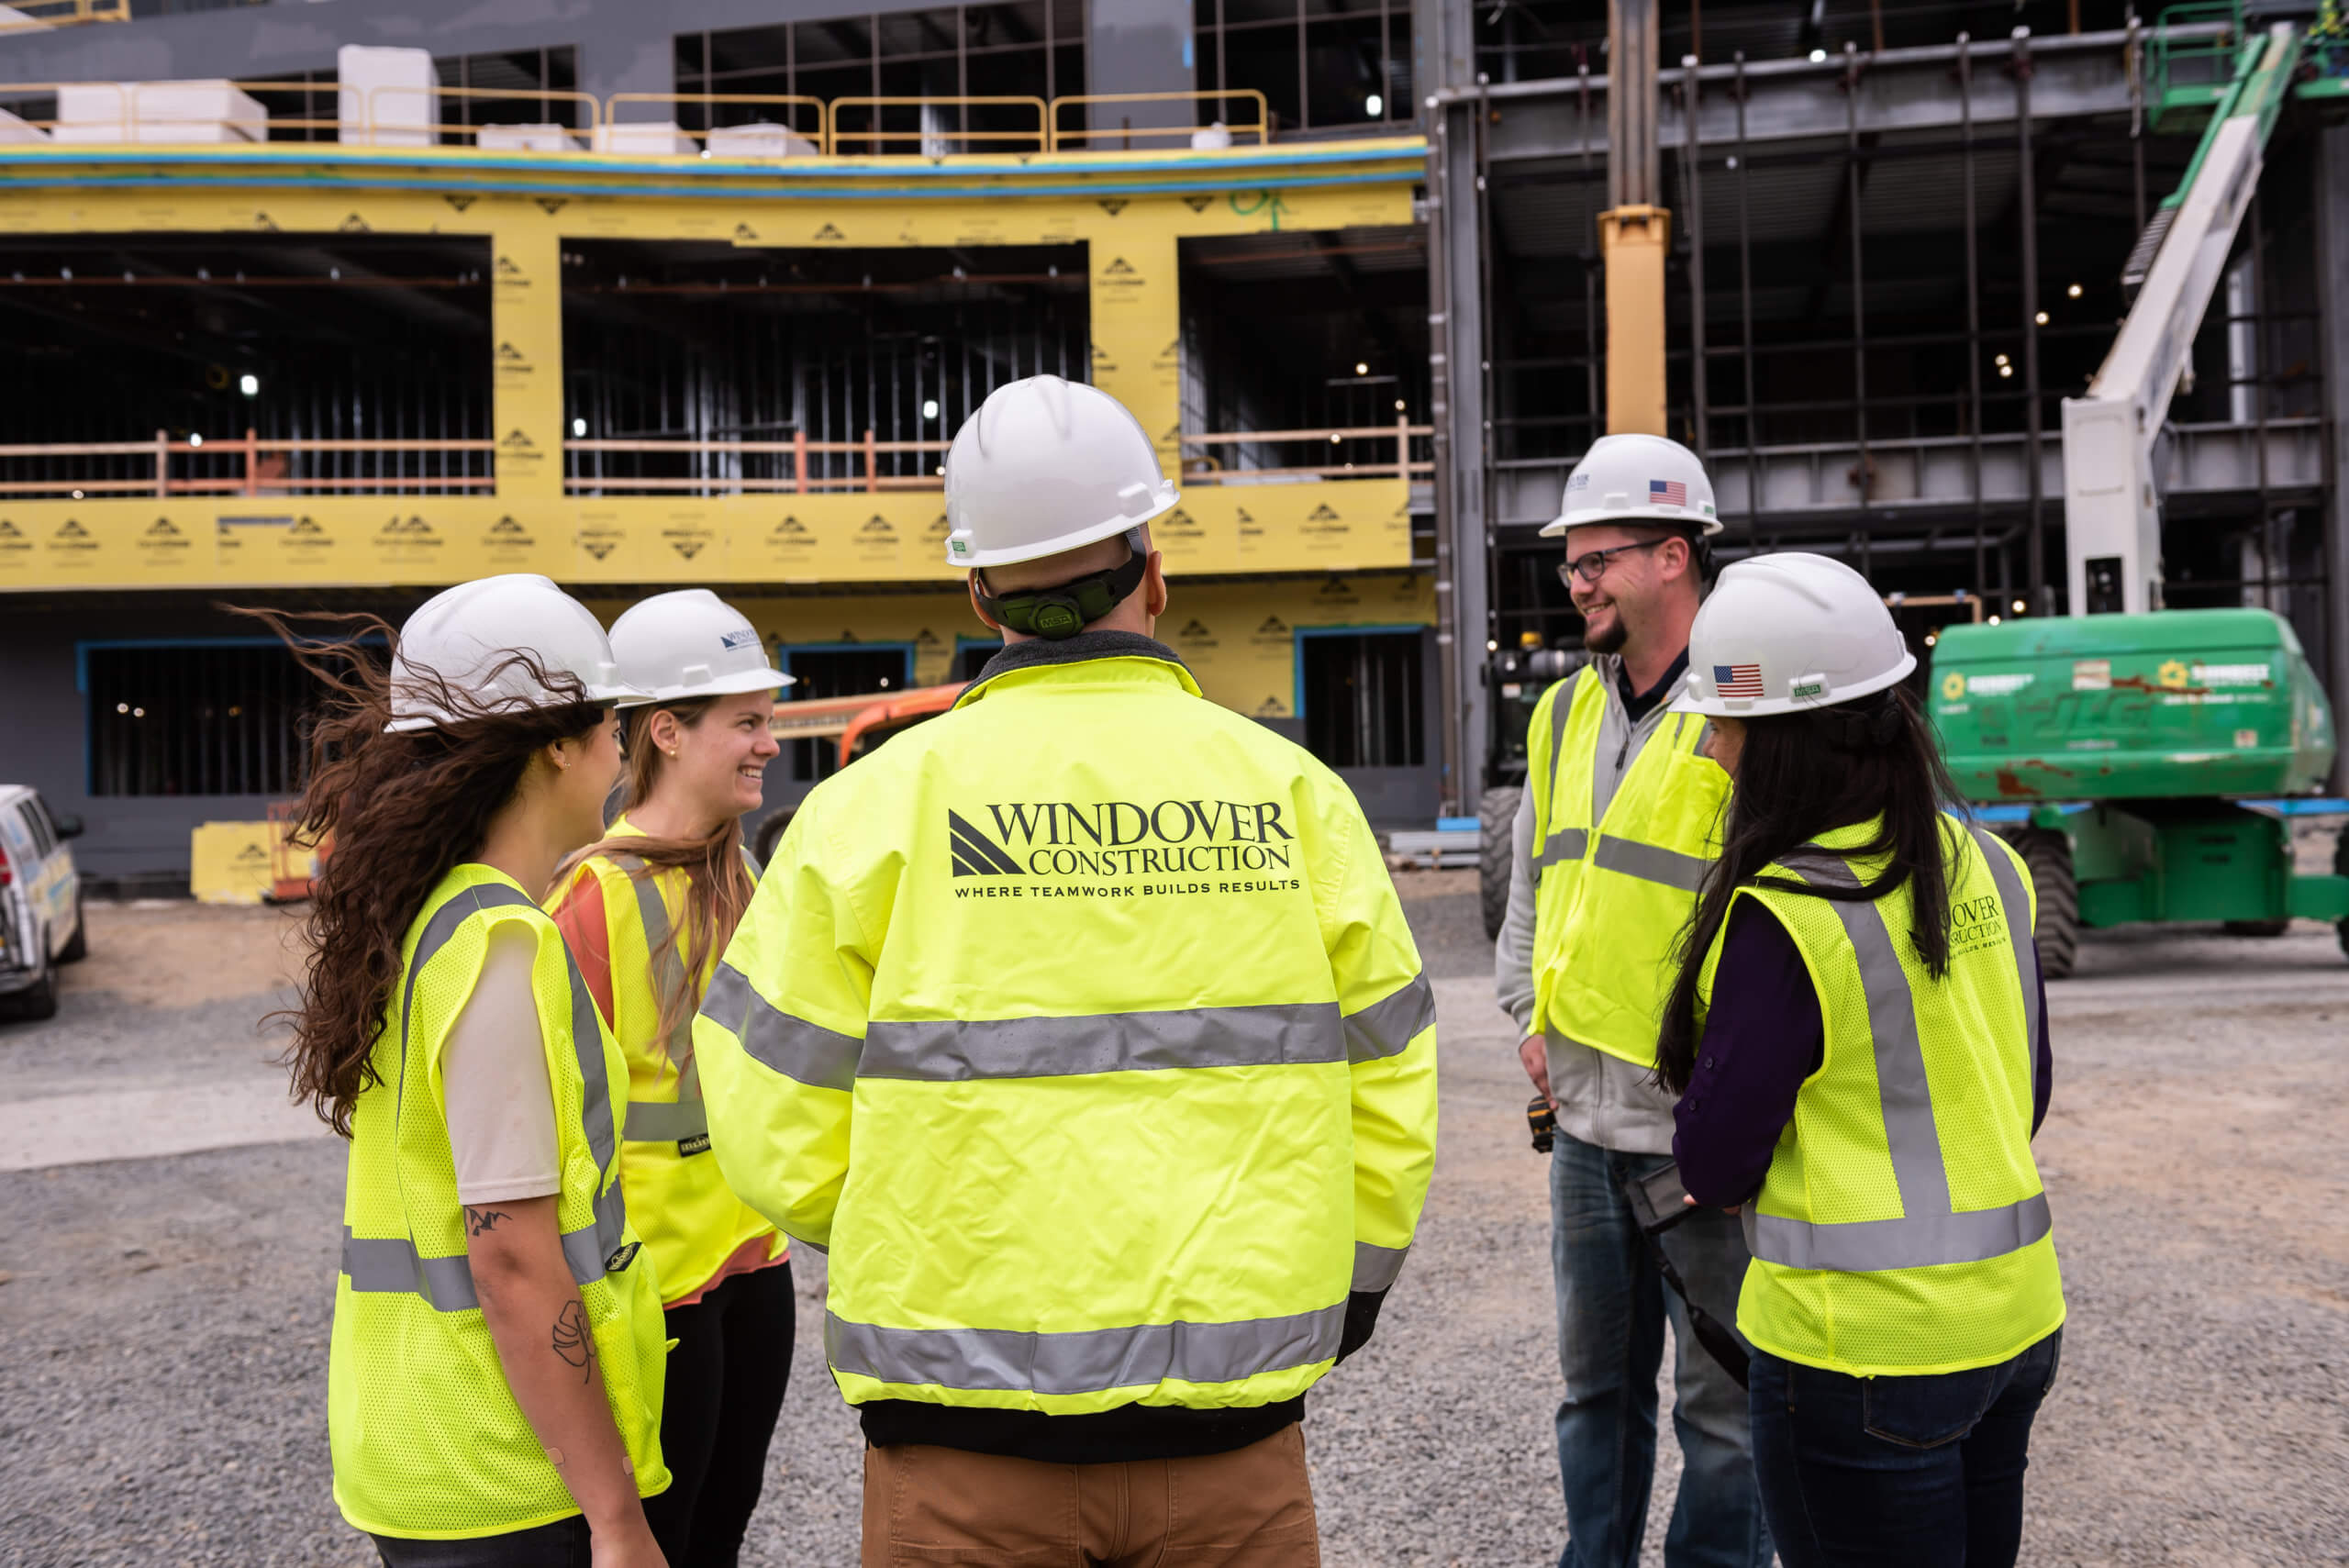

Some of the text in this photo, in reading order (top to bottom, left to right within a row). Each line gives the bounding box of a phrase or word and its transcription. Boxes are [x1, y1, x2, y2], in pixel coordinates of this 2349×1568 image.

[1795, 684, 1820, 697] MSA
[985, 800, 1296, 847] WINDOVER
[1028, 844, 1291, 876] CONSTRUCTION
[955, 879, 1300, 898] WHERE TEAMWORK BUILDS RESULTS
[1952, 895, 1998, 928] OVER
[1950, 920, 2002, 946] RUCTION
